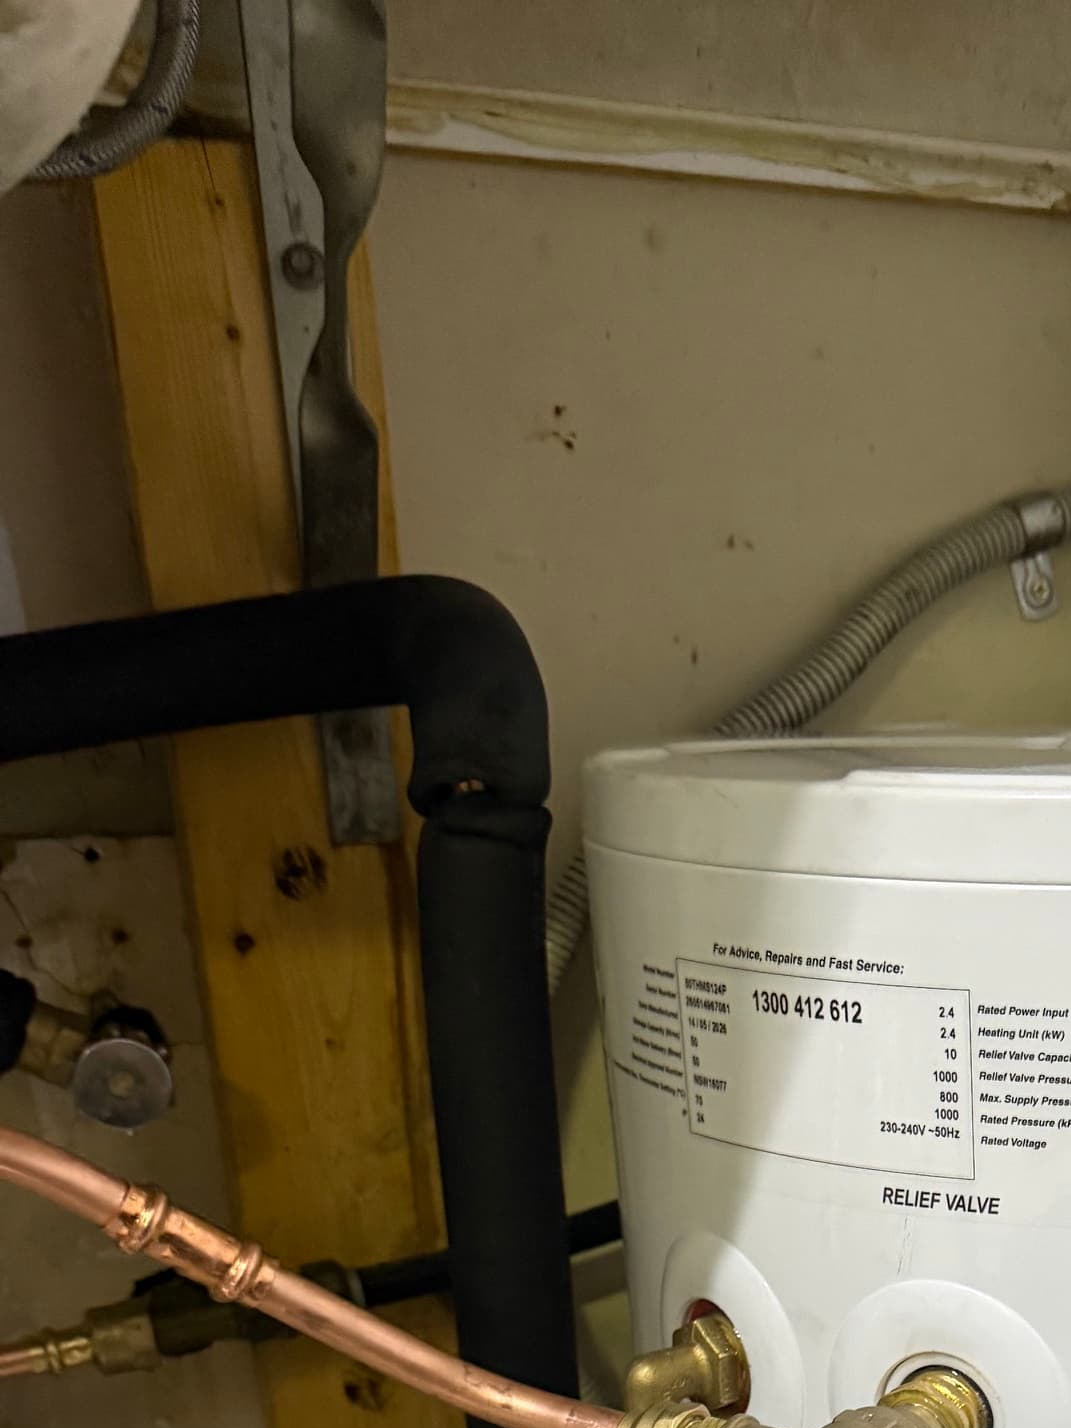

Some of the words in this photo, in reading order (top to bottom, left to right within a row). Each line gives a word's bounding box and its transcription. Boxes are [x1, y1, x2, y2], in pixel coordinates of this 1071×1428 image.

[713, 943, 727, 956] For
[729, 946, 762, 963] Advice,
[765, 950, 803, 966] Repairs
[805, 956, 826, 968] and
[829, 958, 853, 971] Fast
[856, 959, 905, 975] Service:
[752, 989, 789, 1015] 1300
[794, 995, 824, 1020] 412
[830, 999, 863, 1024] 612
[938, 1006, 955, 1019] 2.4
[977, 1005, 1007, 1016] Rated
[1009, 1006, 1040, 1017] Power
[1042, 1008, 1069, 1019] Input
[940, 1027, 956, 1040] 2.4
[977, 1027, 1015, 1040] Heating
[1018, 1029, 1039, 1040] Unit
[1041, 1030, 1065, 1042] (kW)
[944, 1048, 957, 1060] 10
[978, 1049, 1007, 1060] Relief
[1009, 1051, 1035, 1061] Valve
[933, 1070, 958, 1083] 1000
[979, 1071, 1008, 1082] Relief
[1009, 1073, 1035, 1083] Valve
[939, 1091, 958, 1103] 800
[979, 1093, 1002, 1103] Max.
[1004, 1094, 1039, 1107] Supply
[934, 1108, 959, 1121] 1000
[980, 1114, 1008, 1125] Rated
[1010, 1116, 1055, 1127] Pressure
[880, 1121, 926, 1137] 230-240V
[928, 1126, 960, 1139] ~50Hz
[980, 1136, 1009, 1146] Rated
[1011, 1138, 1048, 1150] Voltage
[882, 1186, 941, 1209] RELIEF
[945, 1193, 1001, 1215] VALVE
